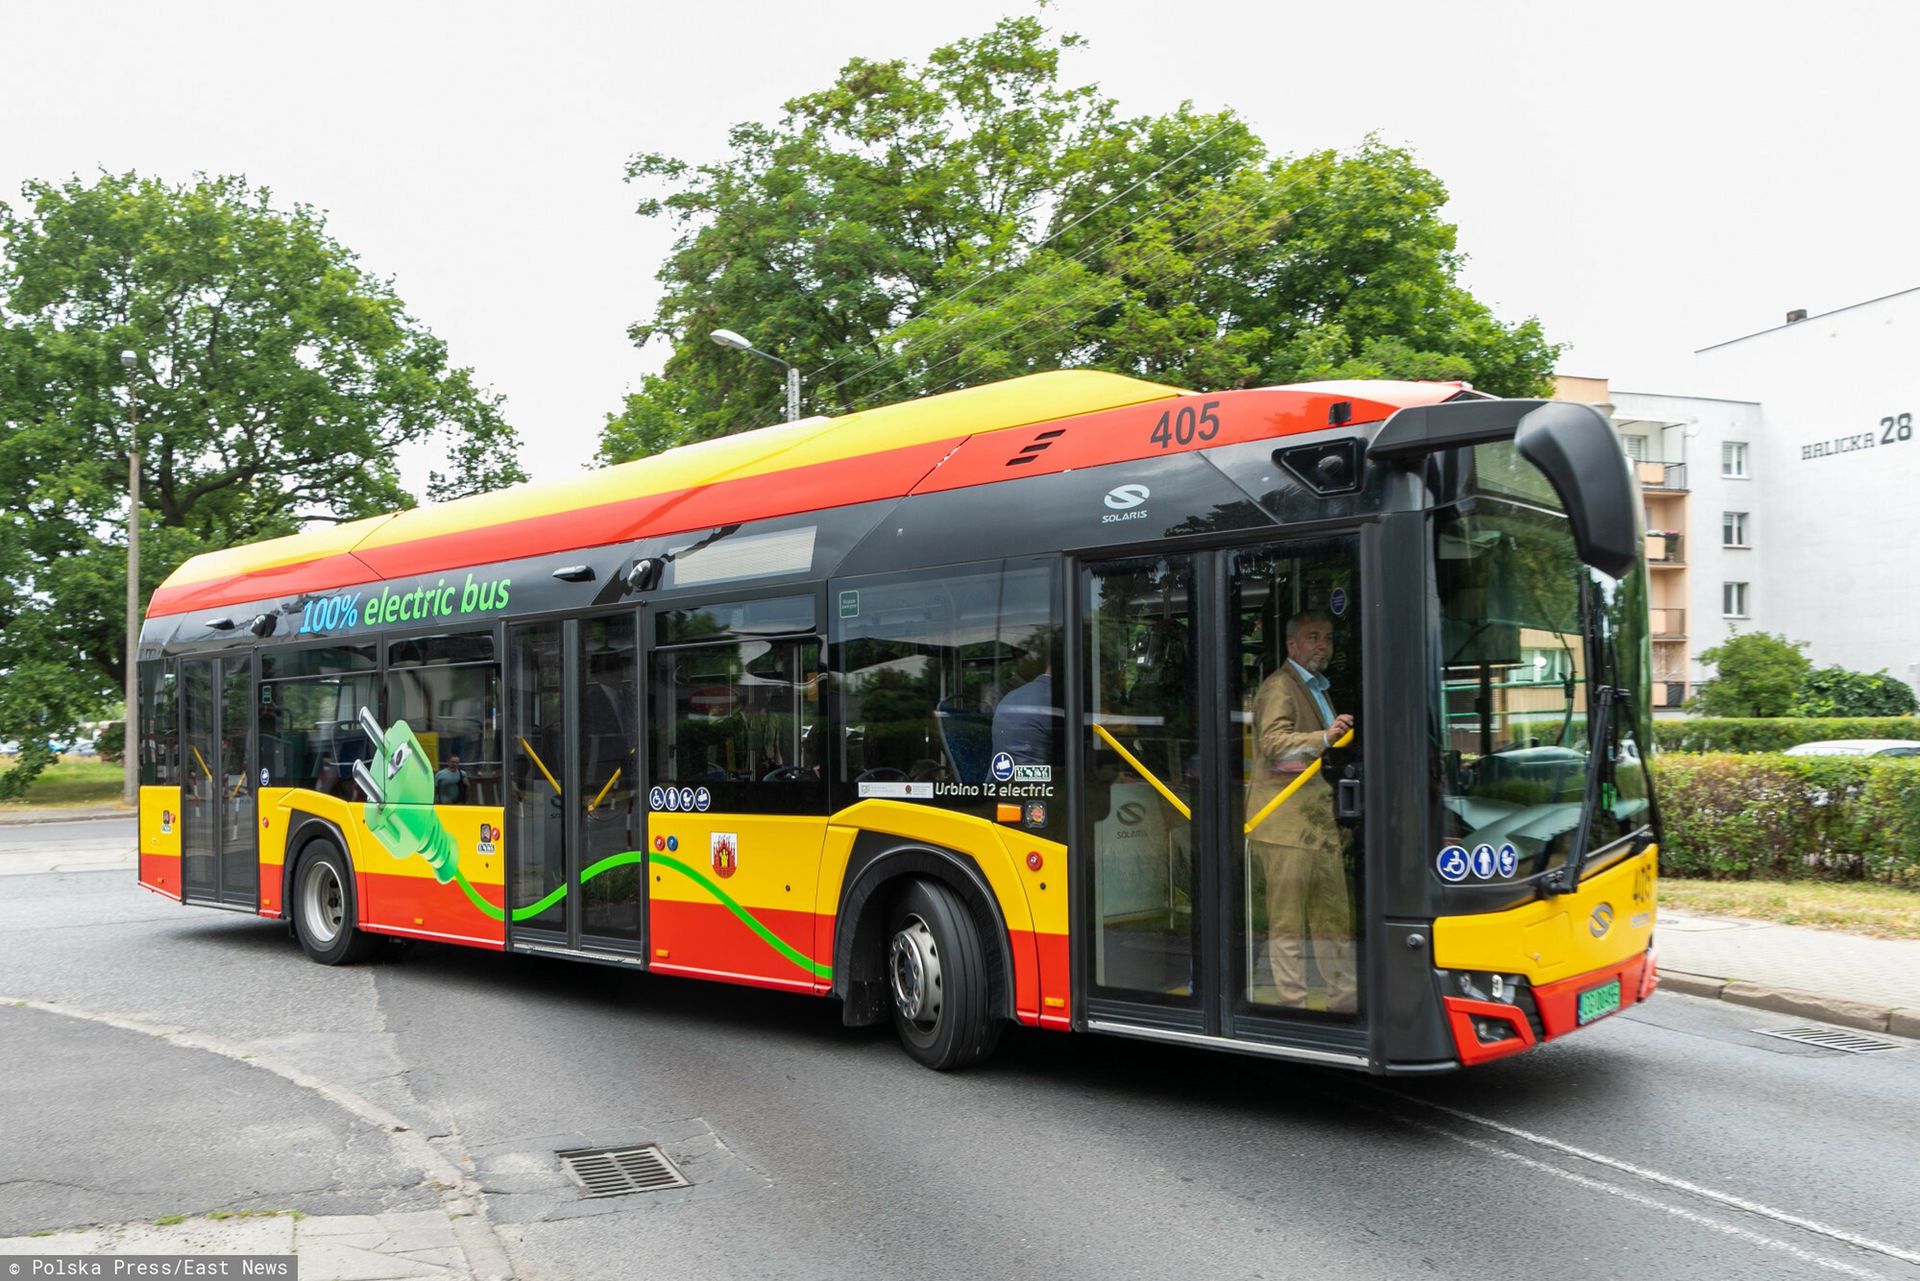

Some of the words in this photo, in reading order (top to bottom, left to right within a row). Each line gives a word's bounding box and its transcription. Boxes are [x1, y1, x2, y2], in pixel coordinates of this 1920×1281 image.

[1150, 401, 1220, 449] 405
[1802, 432, 1875, 461] HALICKA
[1880, 412, 1912, 445] 28
[1102, 510, 1148, 524] SOLARIS
[300, 591, 361, 634] 100%
[363, 578, 456, 626] electric
[460, 573, 511, 614] bus
[935, 782, 979, 797] Urbino
[983, 783, 996, 797] 12
[999, 783, 1054, 797] electric
[1116, 830, 1148, 840] SOLAR
